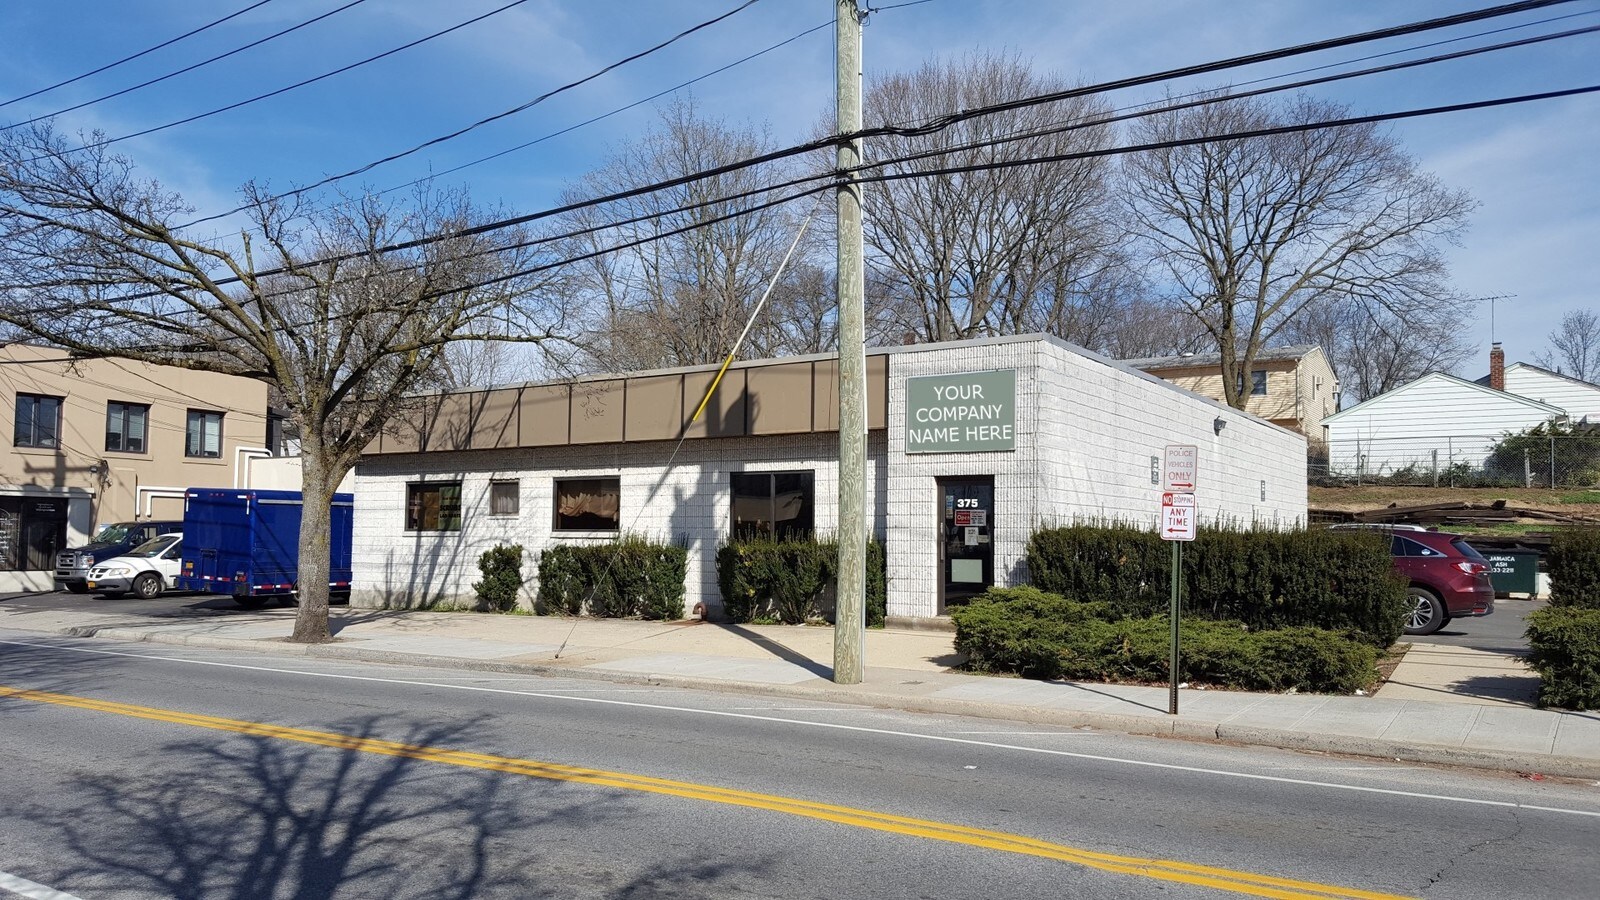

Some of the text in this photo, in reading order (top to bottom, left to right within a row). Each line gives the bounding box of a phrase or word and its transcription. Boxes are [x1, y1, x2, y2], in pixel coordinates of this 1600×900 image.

[933, 384, 984, 400] YOUR
[916, 404, 1002, 422] COMPANY
[909, 425, 1012, 443] NAME HERE
[1169, 471, 1192, 480] ONLY
[957, 498, 978, 508] 375
[1163, 495, 1193, 504] NO STOPPING
[1170, 508, 1187, 516] ANY
[1169, 517, 1188, 526] TIME
